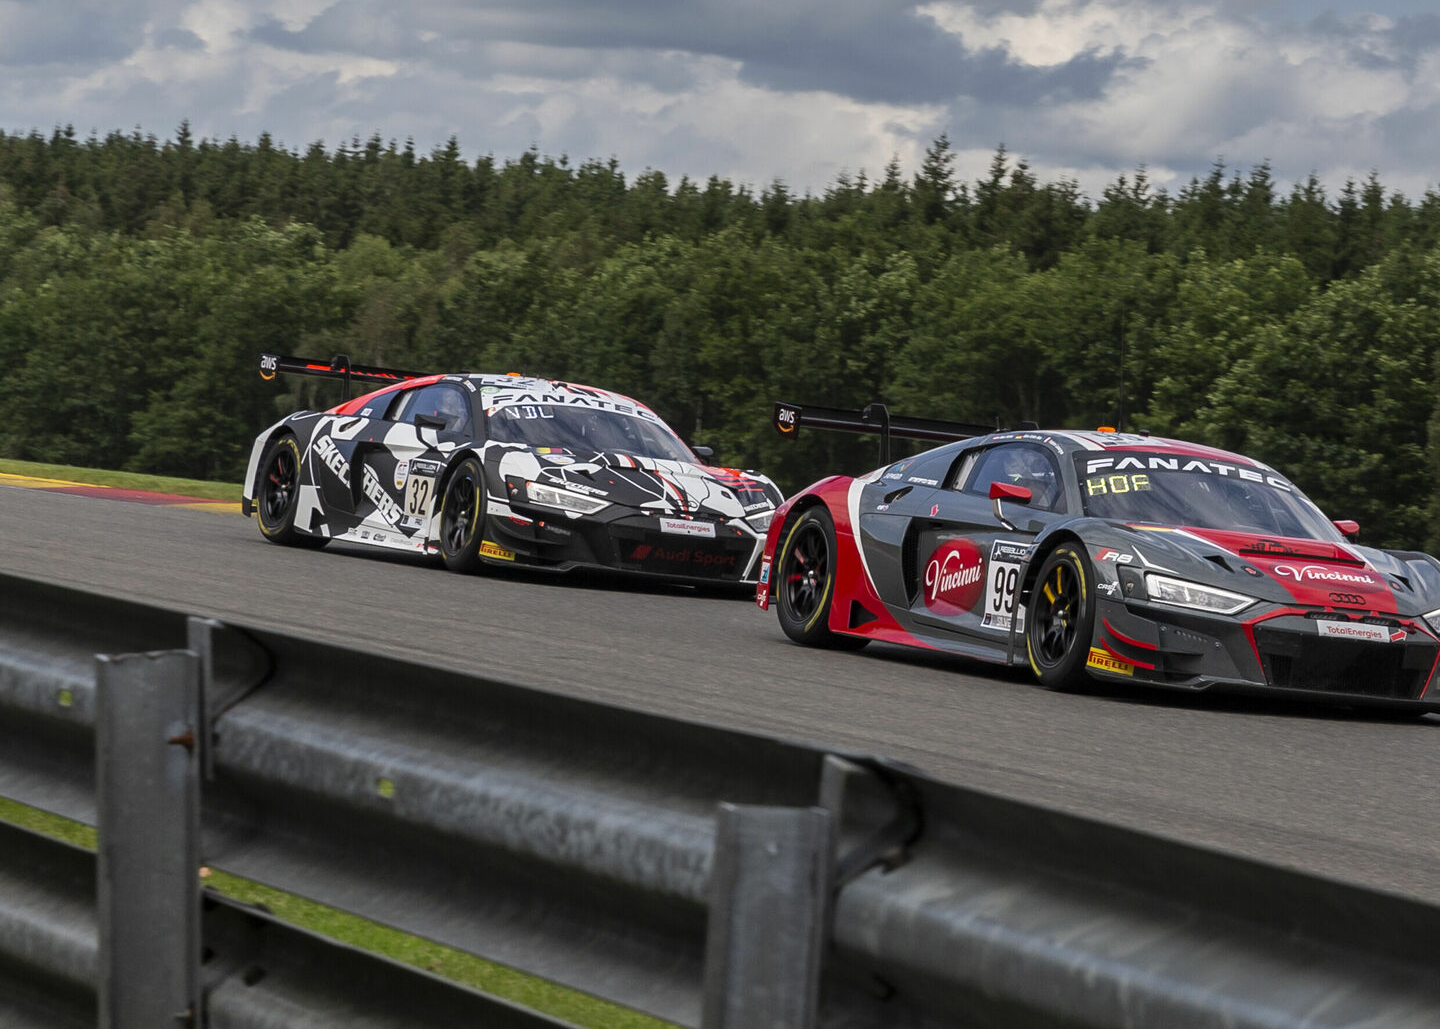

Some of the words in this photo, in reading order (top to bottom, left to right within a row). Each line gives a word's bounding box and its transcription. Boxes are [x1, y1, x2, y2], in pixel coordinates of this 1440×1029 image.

[260, 355, 277, 370] aws
[493, 394, 656, 422] FANATEC
[779, 408, 795, 424] aws
[1087, 457, 1292, 492] FANATEC
[1086, 474, 1150, 496] HOF
[409, 478, 428, 515] 32
[665, 521, 711, 533] TotalEnergies
[481, 543, 514, 558] PIRELLI
[654, 548, 690, 562] Audi
[693, 550, 736, 567] Sport
[925, 549, 982, 601] Vincinni
[1274, 565, 1375, 584] Vincinni
[993, 566, 1019, 614] 99
[1326, 625, 1383, 639] TotalEnergies
[1088, 650, 1129, 671] PIRELLI
